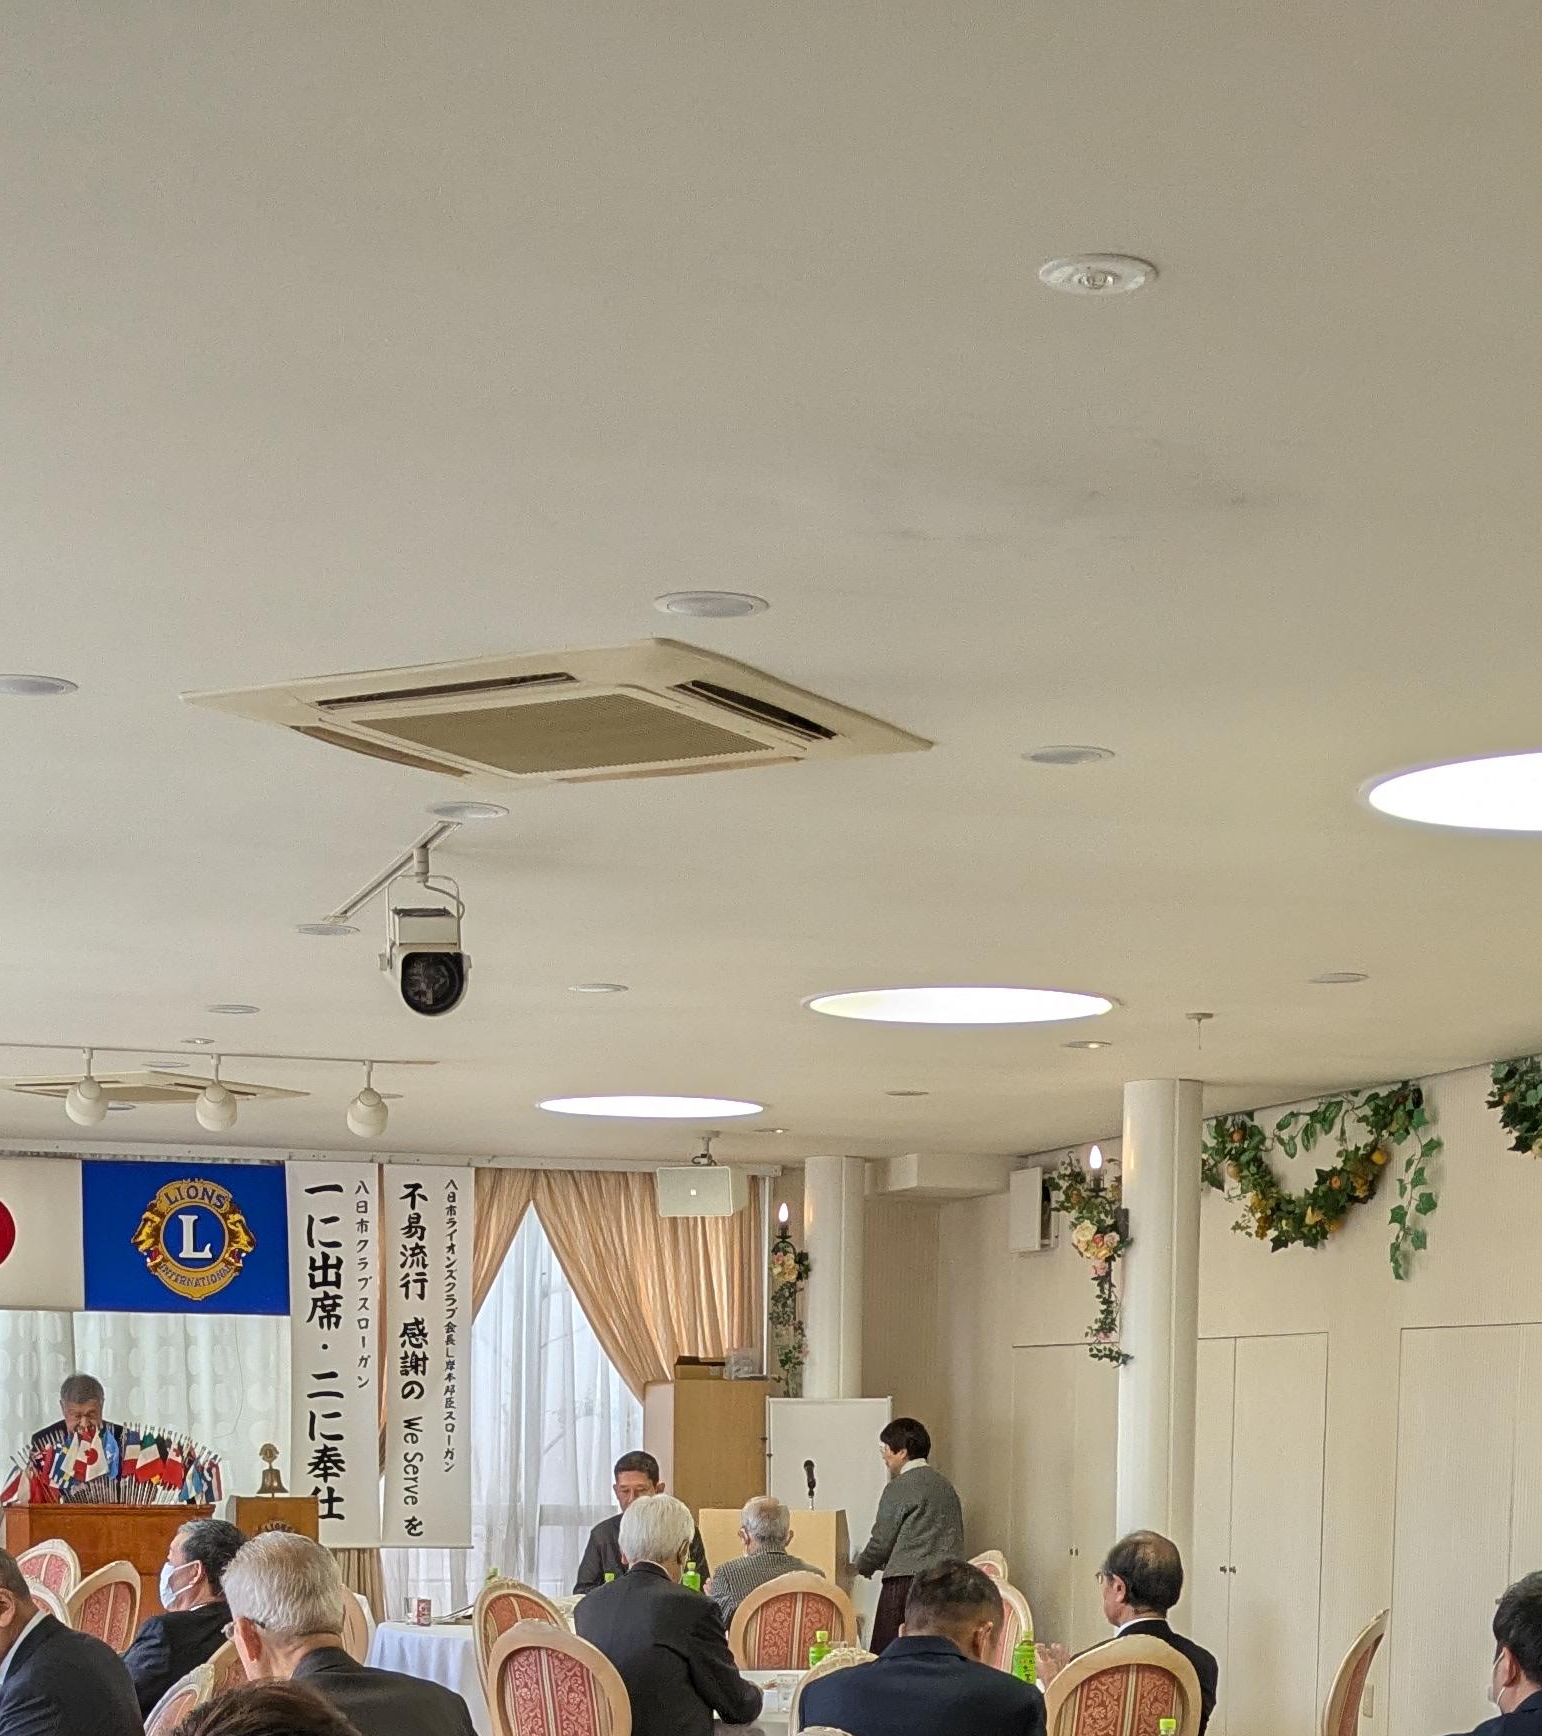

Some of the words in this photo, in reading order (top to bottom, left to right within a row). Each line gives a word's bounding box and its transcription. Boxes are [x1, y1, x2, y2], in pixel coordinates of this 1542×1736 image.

[164, 1185, 227, 1208] LIONS
[178, 1214, 212, 1258] L
[399, 1183, 429, 1301] 不易流行
[159, 1262, 234, 1288] INTERNATIONAL
[355, 1180, 372, 1389] 八日市クラブスローガン
[399, 1317, 429, 1400] 感謝の
[403, 1416, 424, 1445] We
[403, 1452, 424, 1506] Serve
[403, 1515, 424, 1537] を
